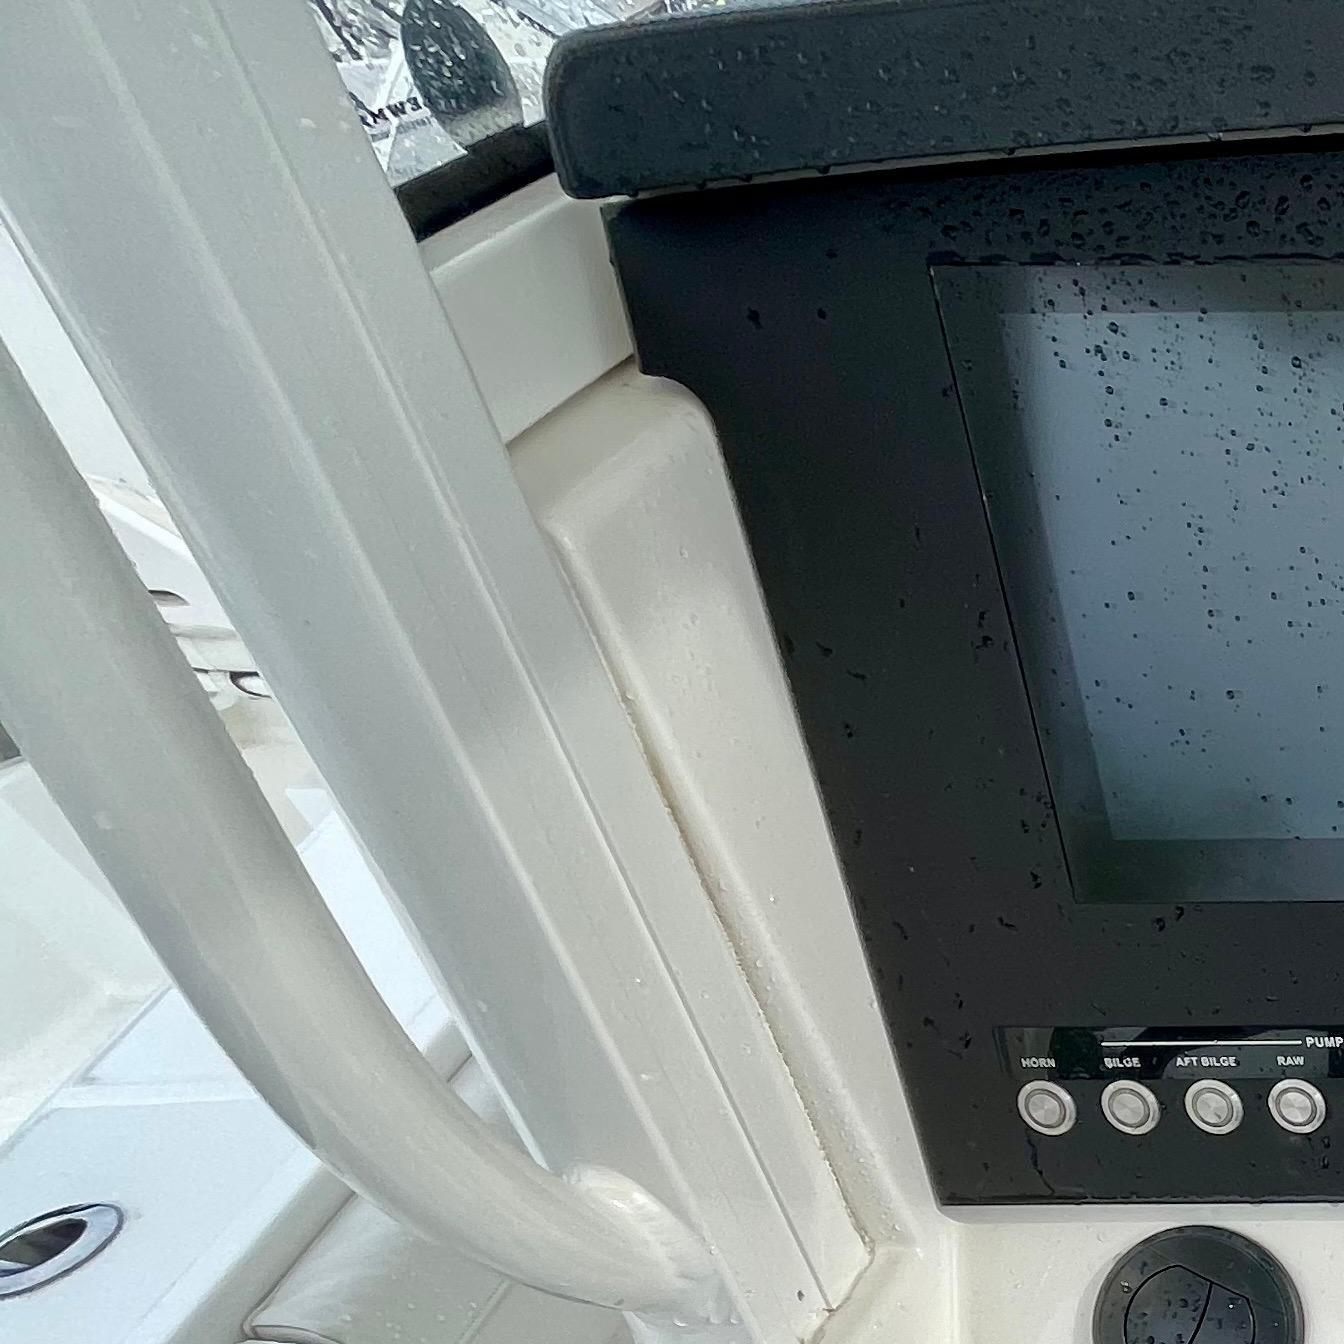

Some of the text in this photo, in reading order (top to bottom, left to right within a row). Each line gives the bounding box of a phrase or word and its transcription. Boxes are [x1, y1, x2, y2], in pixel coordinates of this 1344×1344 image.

[1021, 1057, 1056, 1069] HORN
[1104, 1056, 1141, 1069] BILGE
[1176, 1055, 1238, 1068] AFT BILGE
[1277, 1055, 1305, 1066] RAW
